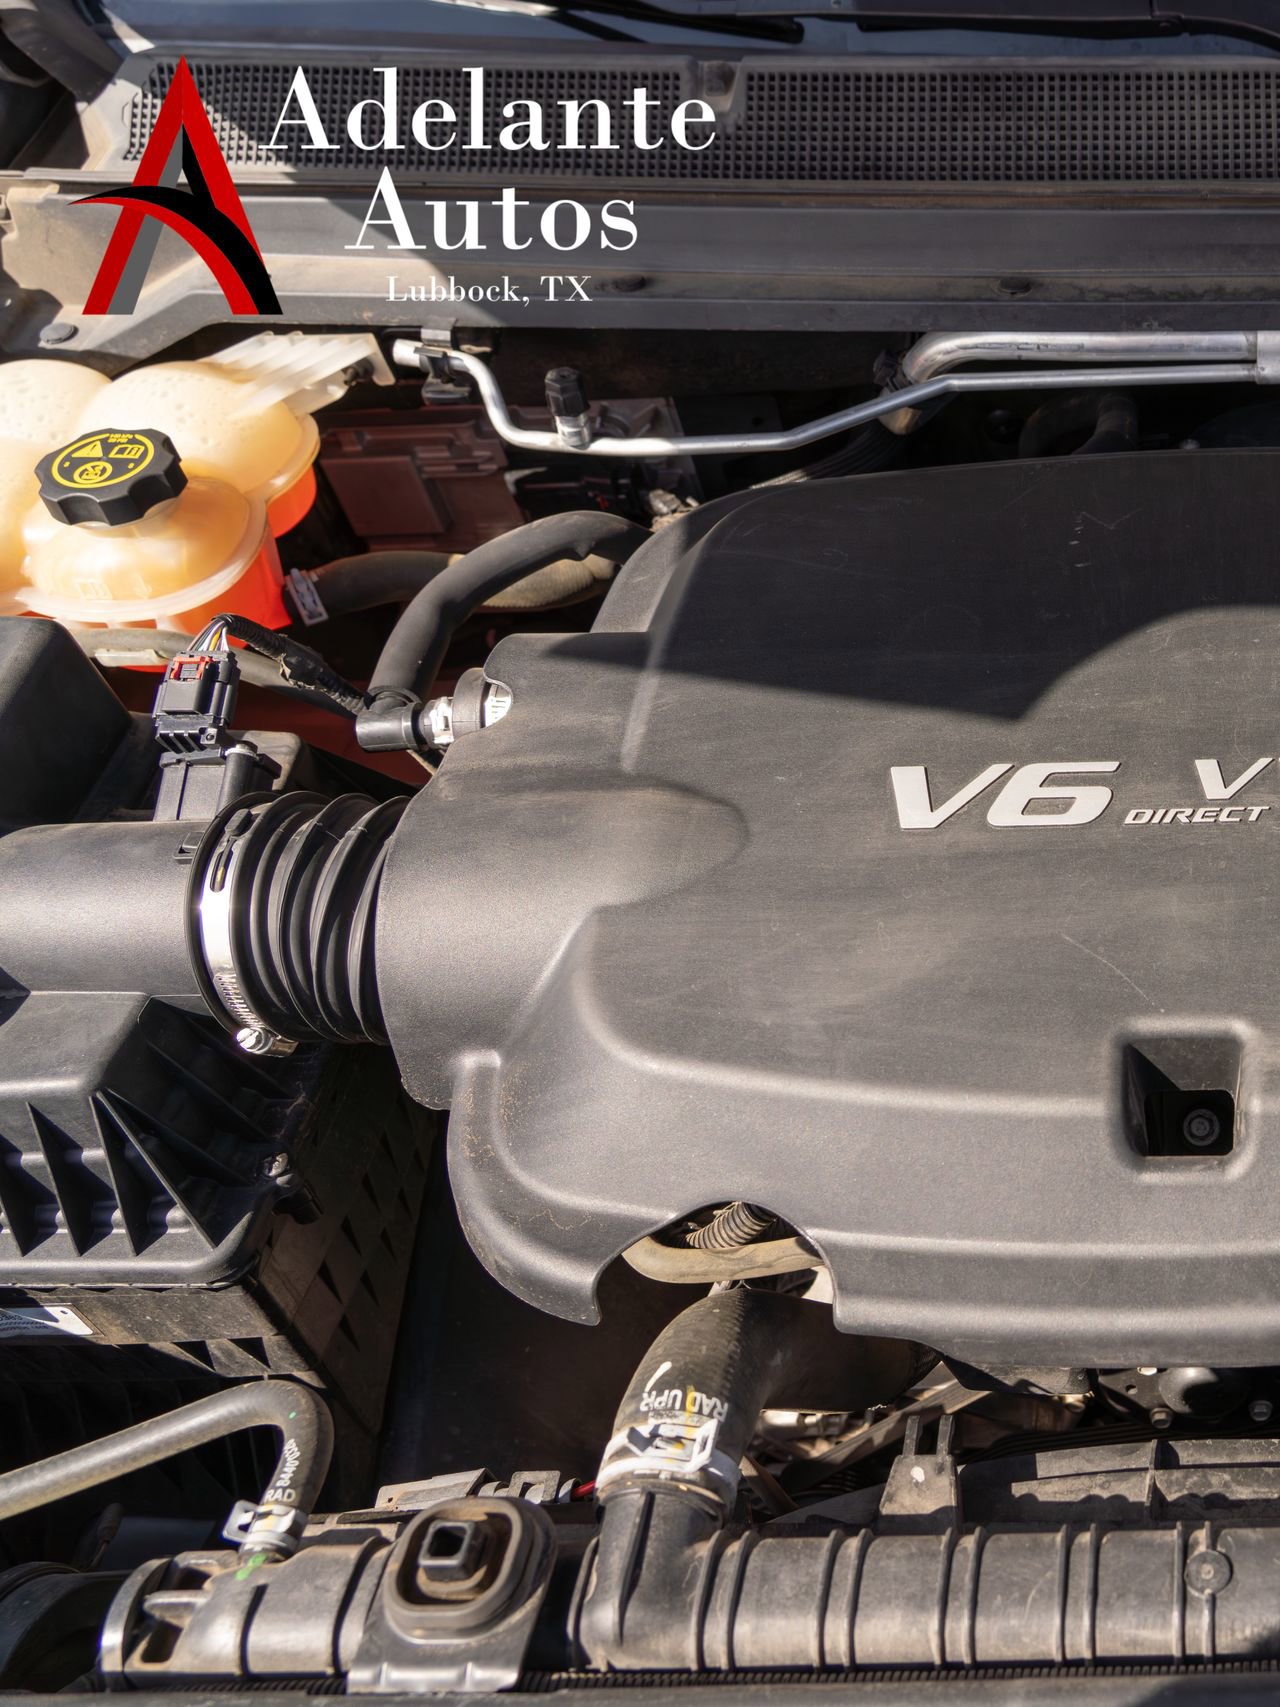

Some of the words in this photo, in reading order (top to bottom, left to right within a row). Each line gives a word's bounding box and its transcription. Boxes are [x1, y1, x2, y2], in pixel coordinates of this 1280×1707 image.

[890, 761, 1121, 830] V6
[1123, 805, 1271, 825] DIRECT
[686, 1391, 729, 1423] RAD
[264, 1488, 297, 1502] RAD
